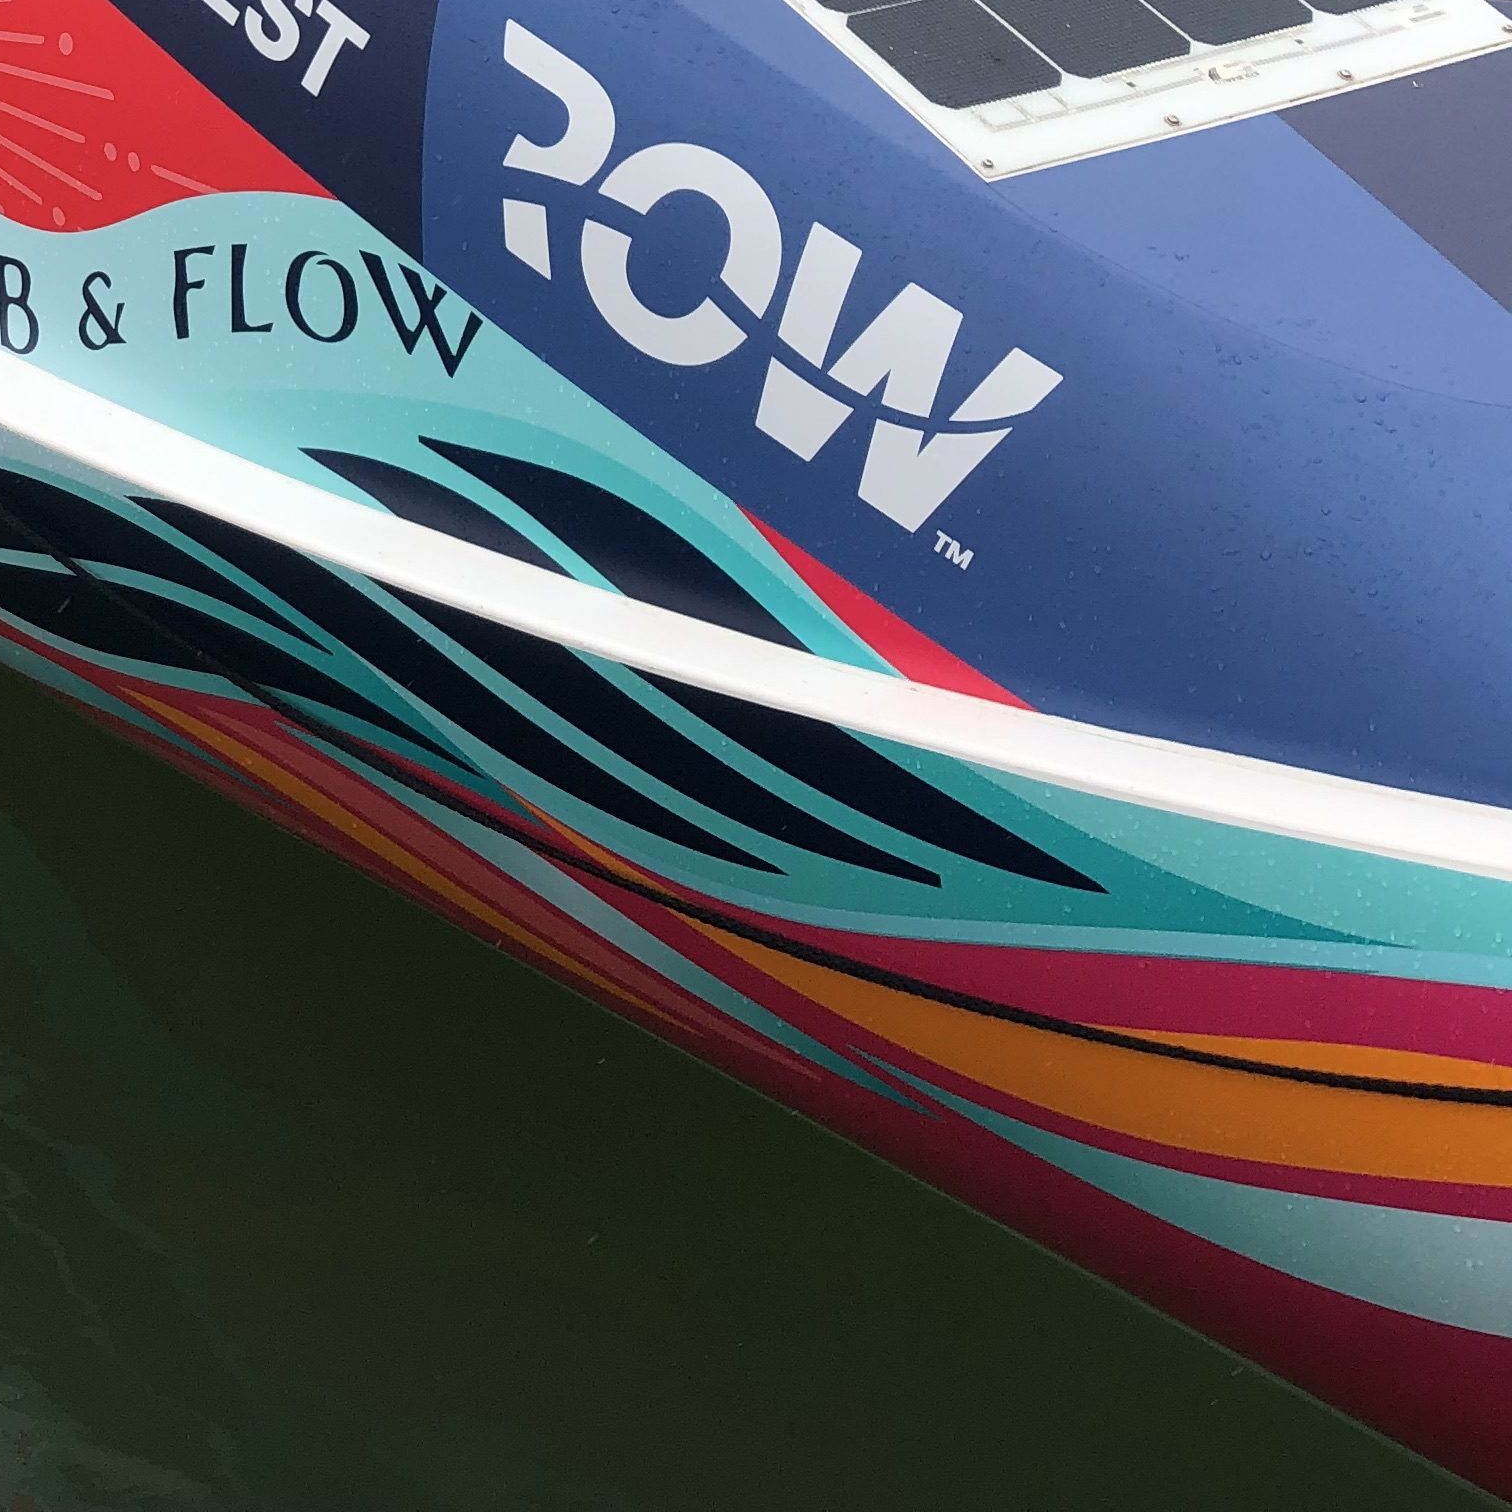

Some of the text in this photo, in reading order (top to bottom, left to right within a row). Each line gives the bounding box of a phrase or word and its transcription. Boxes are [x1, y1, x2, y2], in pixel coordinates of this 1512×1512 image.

[78, 271, 127, 351] &
[172, 244, 484, 378] FLOW
[503, 18, 1064, 533] ROW
